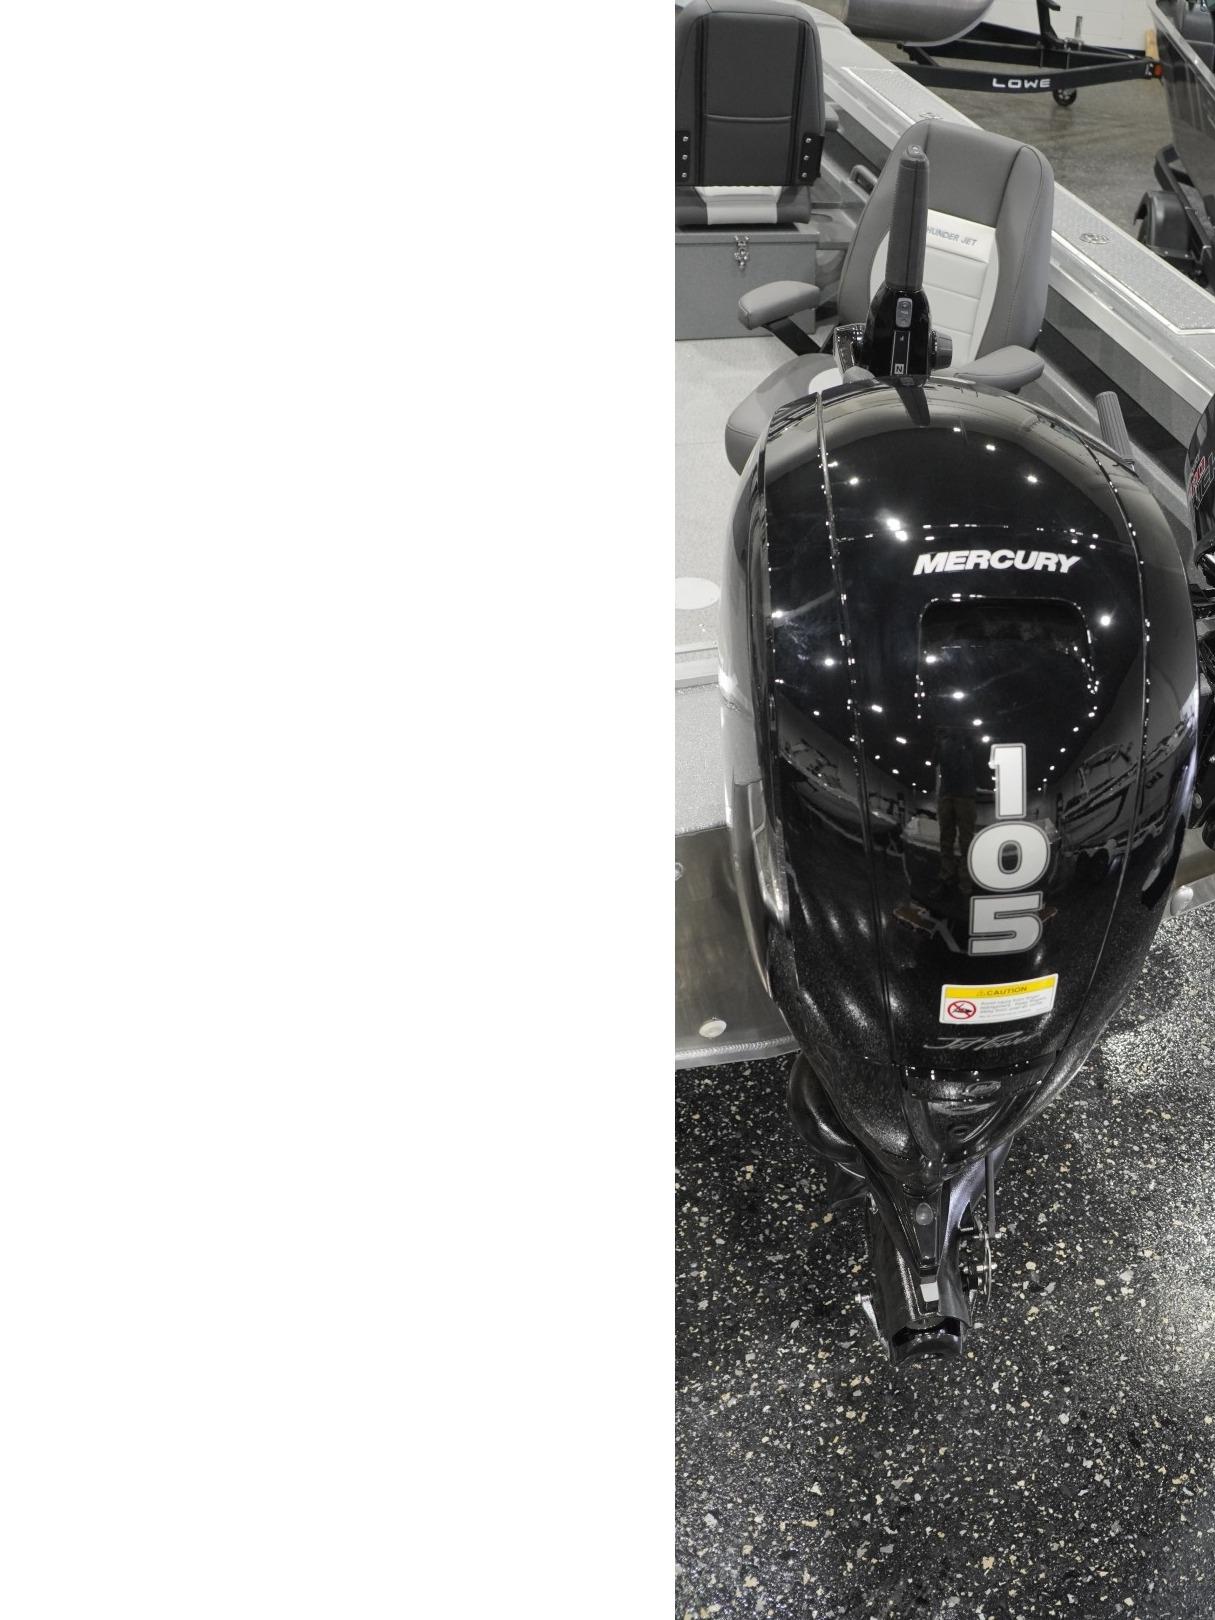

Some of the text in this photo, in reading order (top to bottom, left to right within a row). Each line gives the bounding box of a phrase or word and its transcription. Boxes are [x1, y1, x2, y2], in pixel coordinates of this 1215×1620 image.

[992, 78, 1051, 88] LOWE
[926, 226, 978, 246] HUNDER JET
[913, 549, 1081, 576] MERCURY
[967, 743, 1051, 956] 105
[986, 987, 1028, 996] CAUTION
